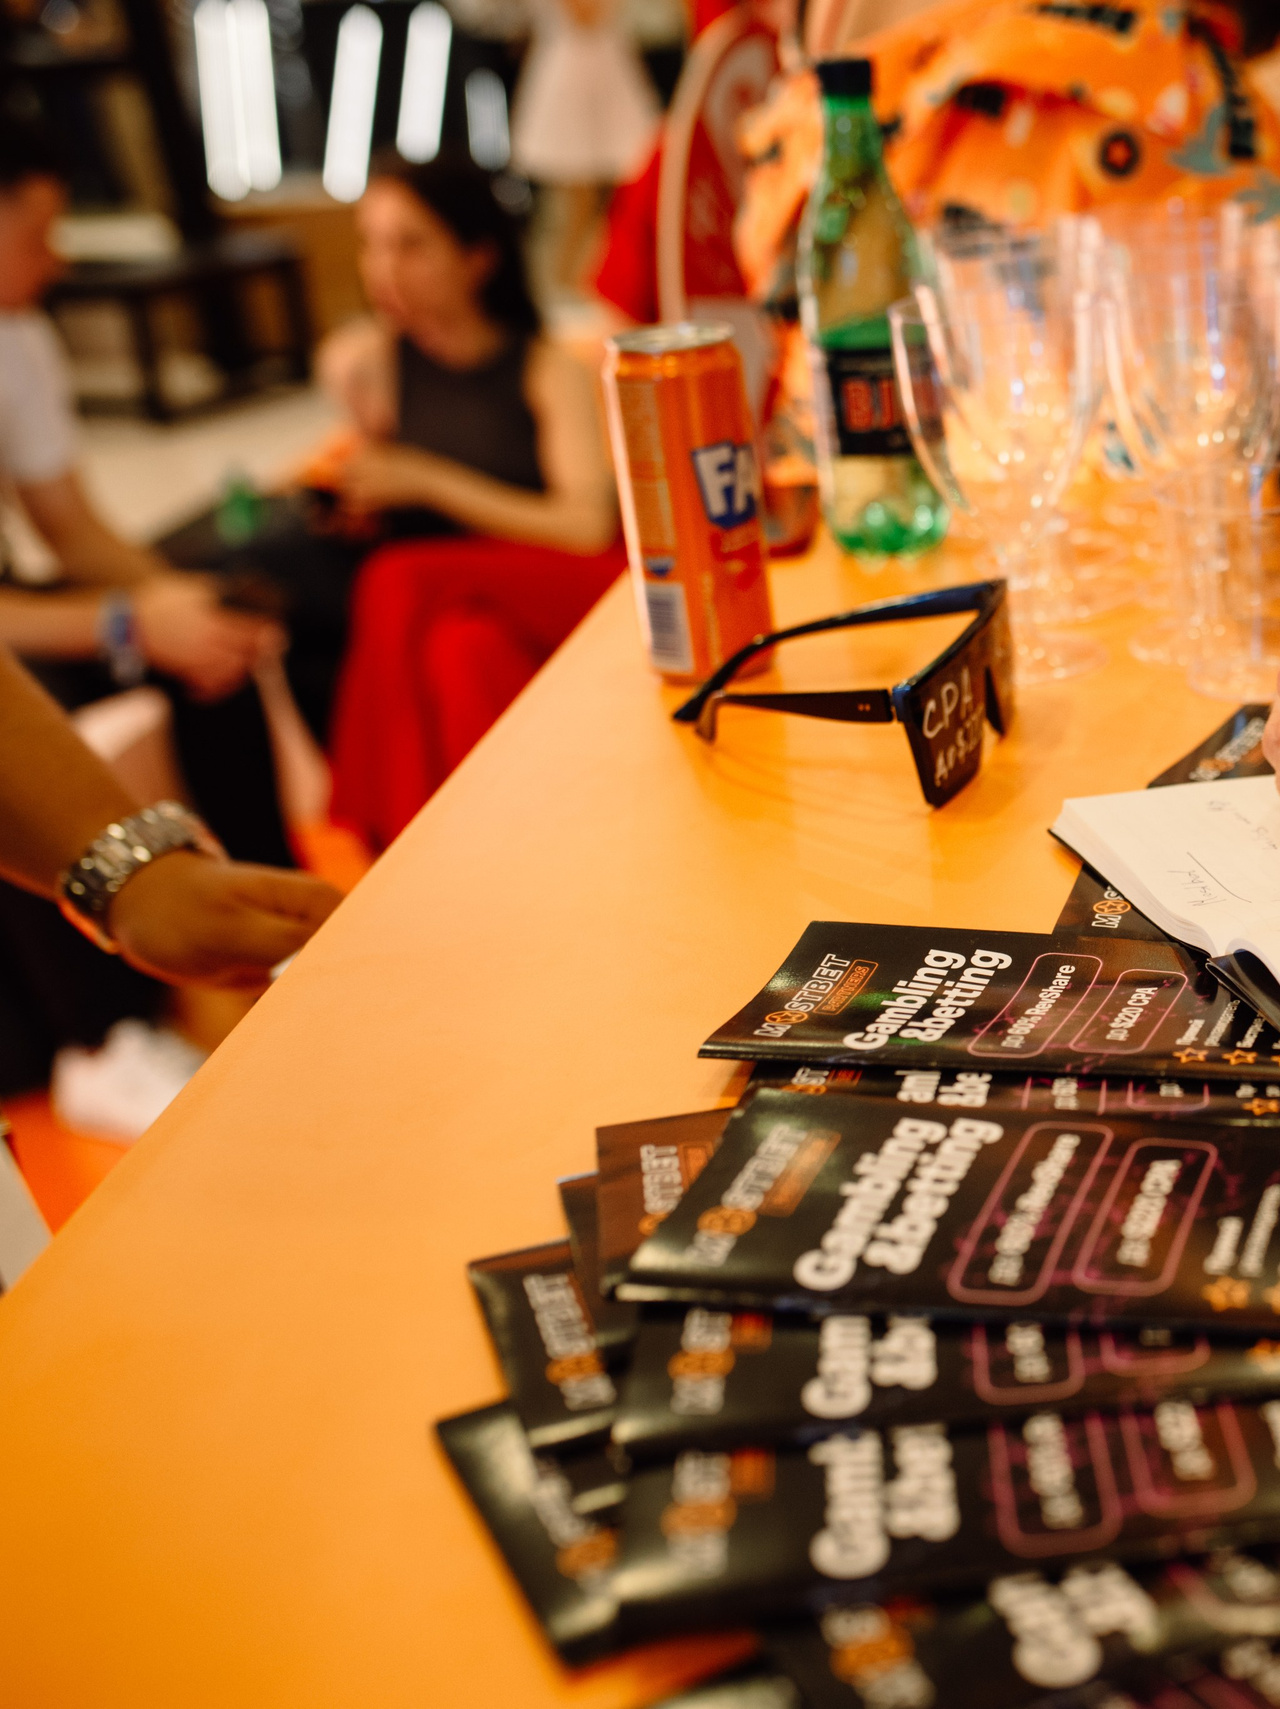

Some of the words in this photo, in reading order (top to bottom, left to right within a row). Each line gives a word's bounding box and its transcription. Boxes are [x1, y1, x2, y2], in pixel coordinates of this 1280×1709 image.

[922, 666, 974, 740] CPA
[843, 949, 966, 1050] Gambling
[899, 949, 1013, 1042] &betting
[1025, 964, 1076, 1022] RevShare
[1133, 987, 1159, 1007] CPA
[793, 1117, 947, 1291] Gambling
